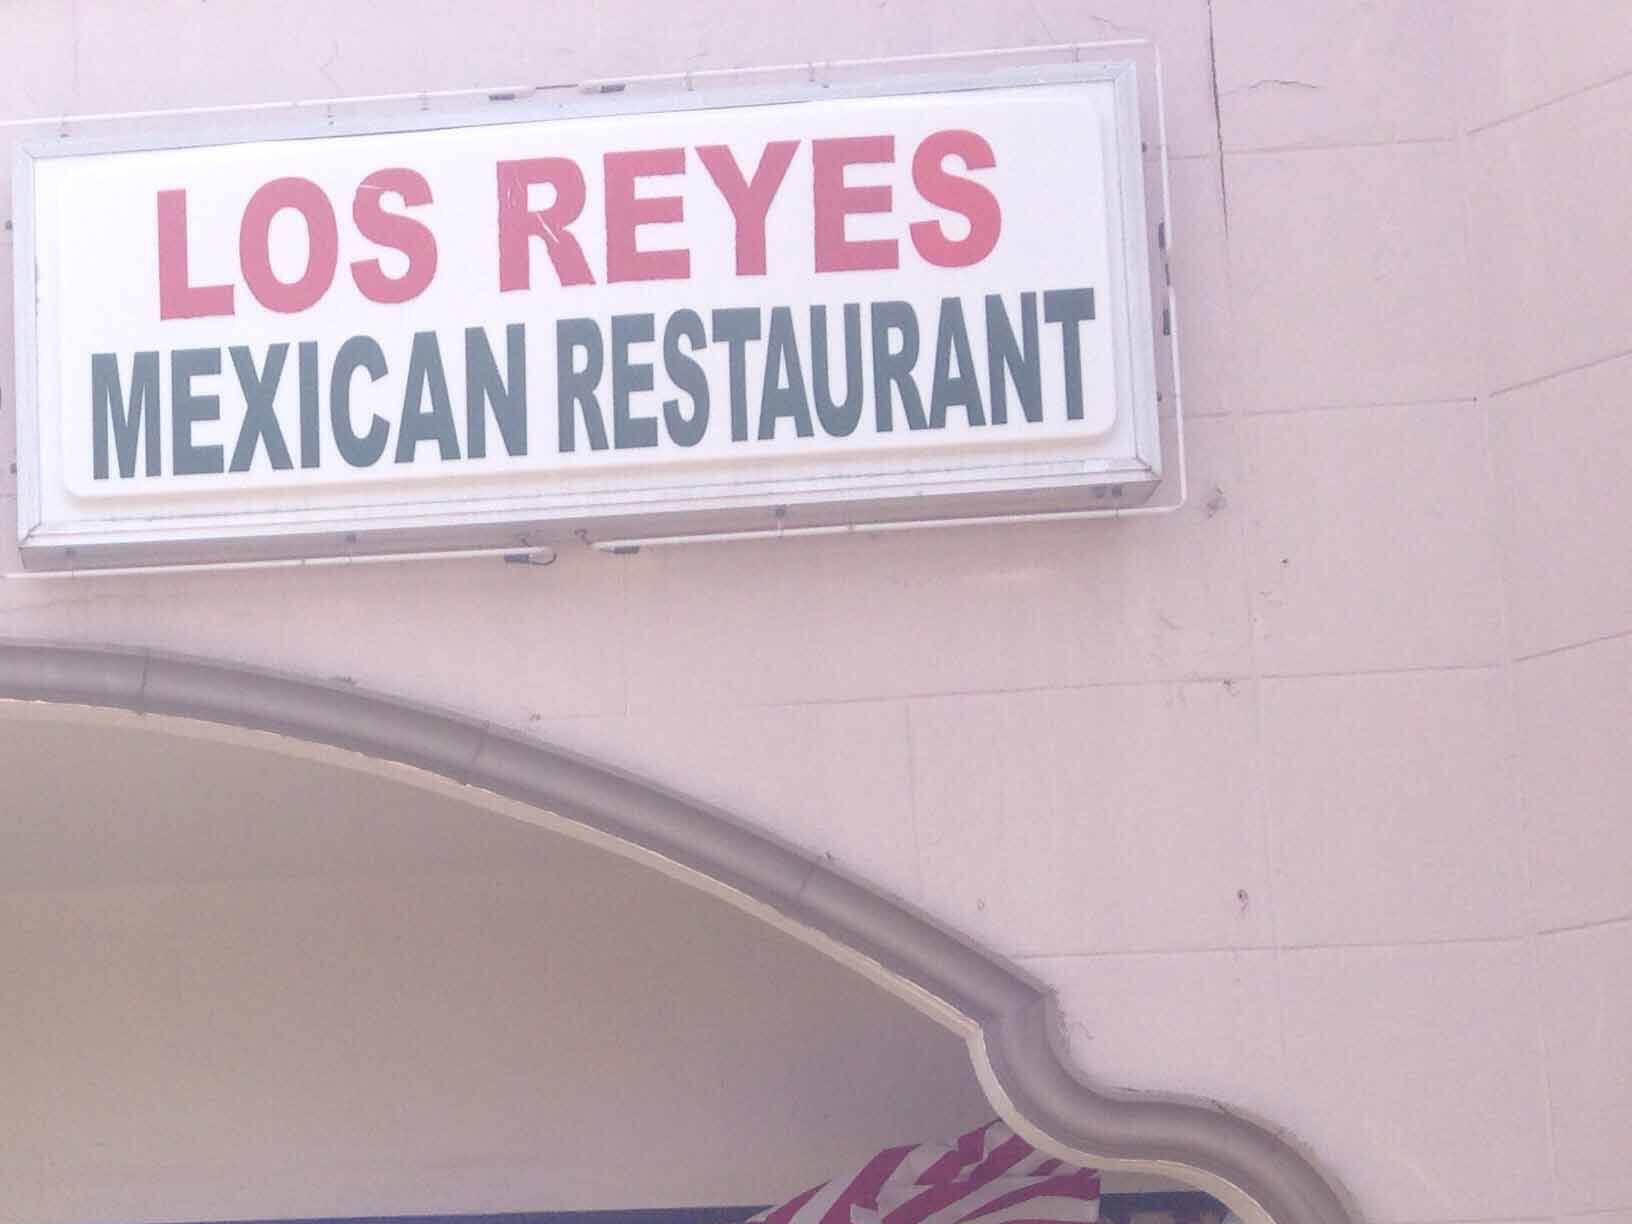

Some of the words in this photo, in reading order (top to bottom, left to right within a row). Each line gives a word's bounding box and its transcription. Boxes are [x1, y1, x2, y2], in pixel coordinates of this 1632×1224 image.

[158, 167, 438, 320] LOS
[497, 129, 1002, 292] REYES
[91, 323, 527, 480] MEXICAN
[557, 287, 1096, 453] RESTAURANT
